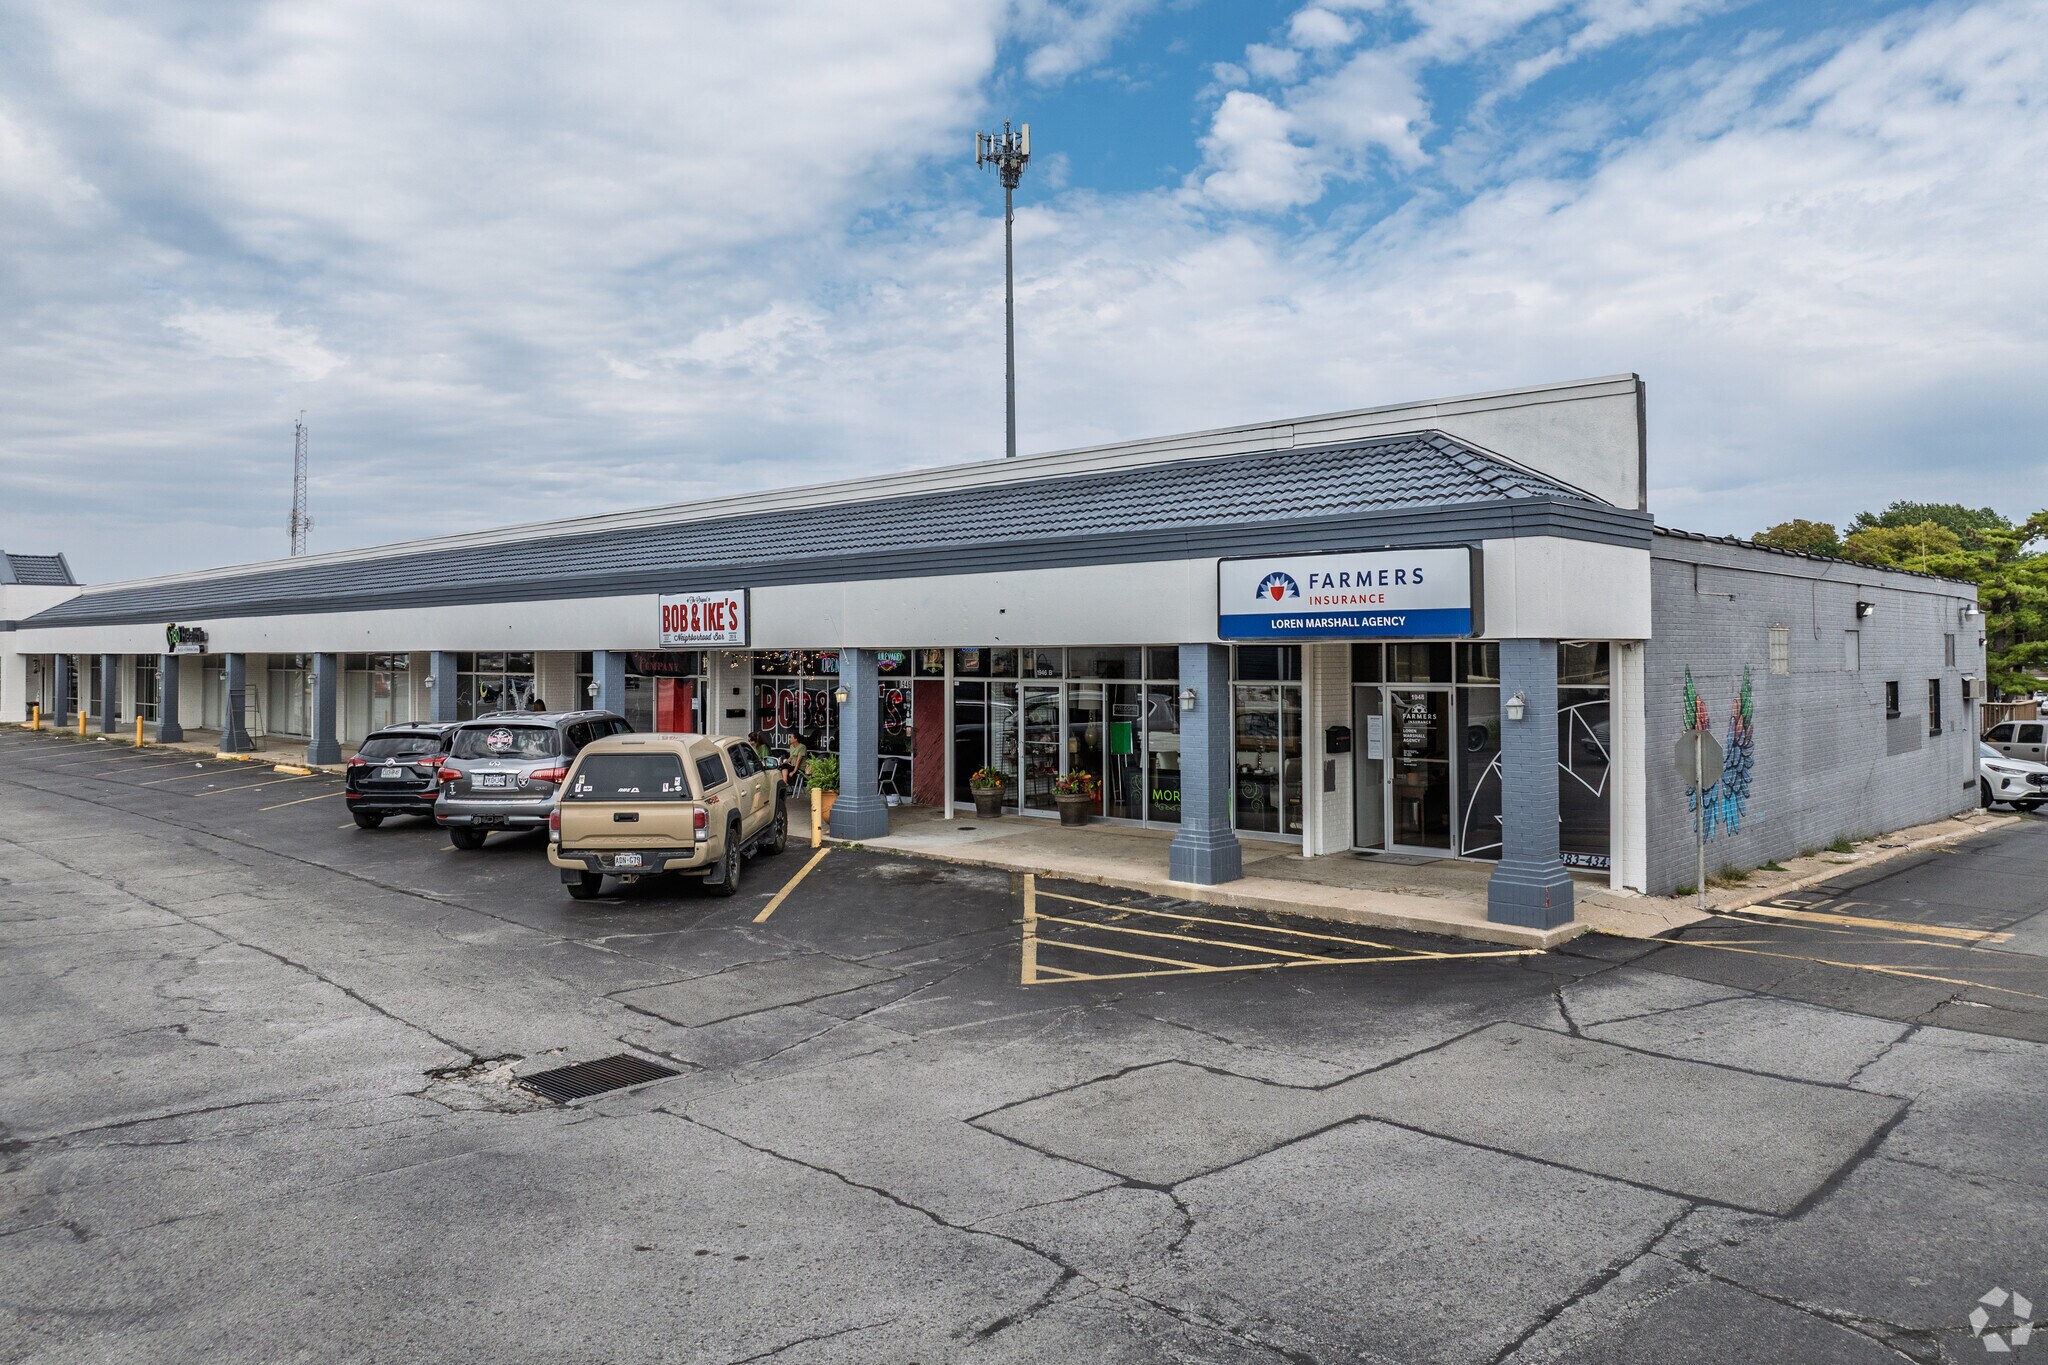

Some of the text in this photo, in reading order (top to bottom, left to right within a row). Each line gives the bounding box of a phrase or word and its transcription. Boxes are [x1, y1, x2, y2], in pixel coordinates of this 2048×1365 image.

[1309, 567, 1424, 589] FARMERS
[1309, 593, 1385, 606] INSURANCE
[662, 597, 738, 633] BOB & IKE'S
[1271, 615, 1406, 629] LOREN MARSHALL AGENCY
[673, 632, 712, 643] Neighborhood
[713, 632, 725, 641] Bar
[640, 656, 680, 674] COMPANY
[1152, 788, 1181, 802] MOR
